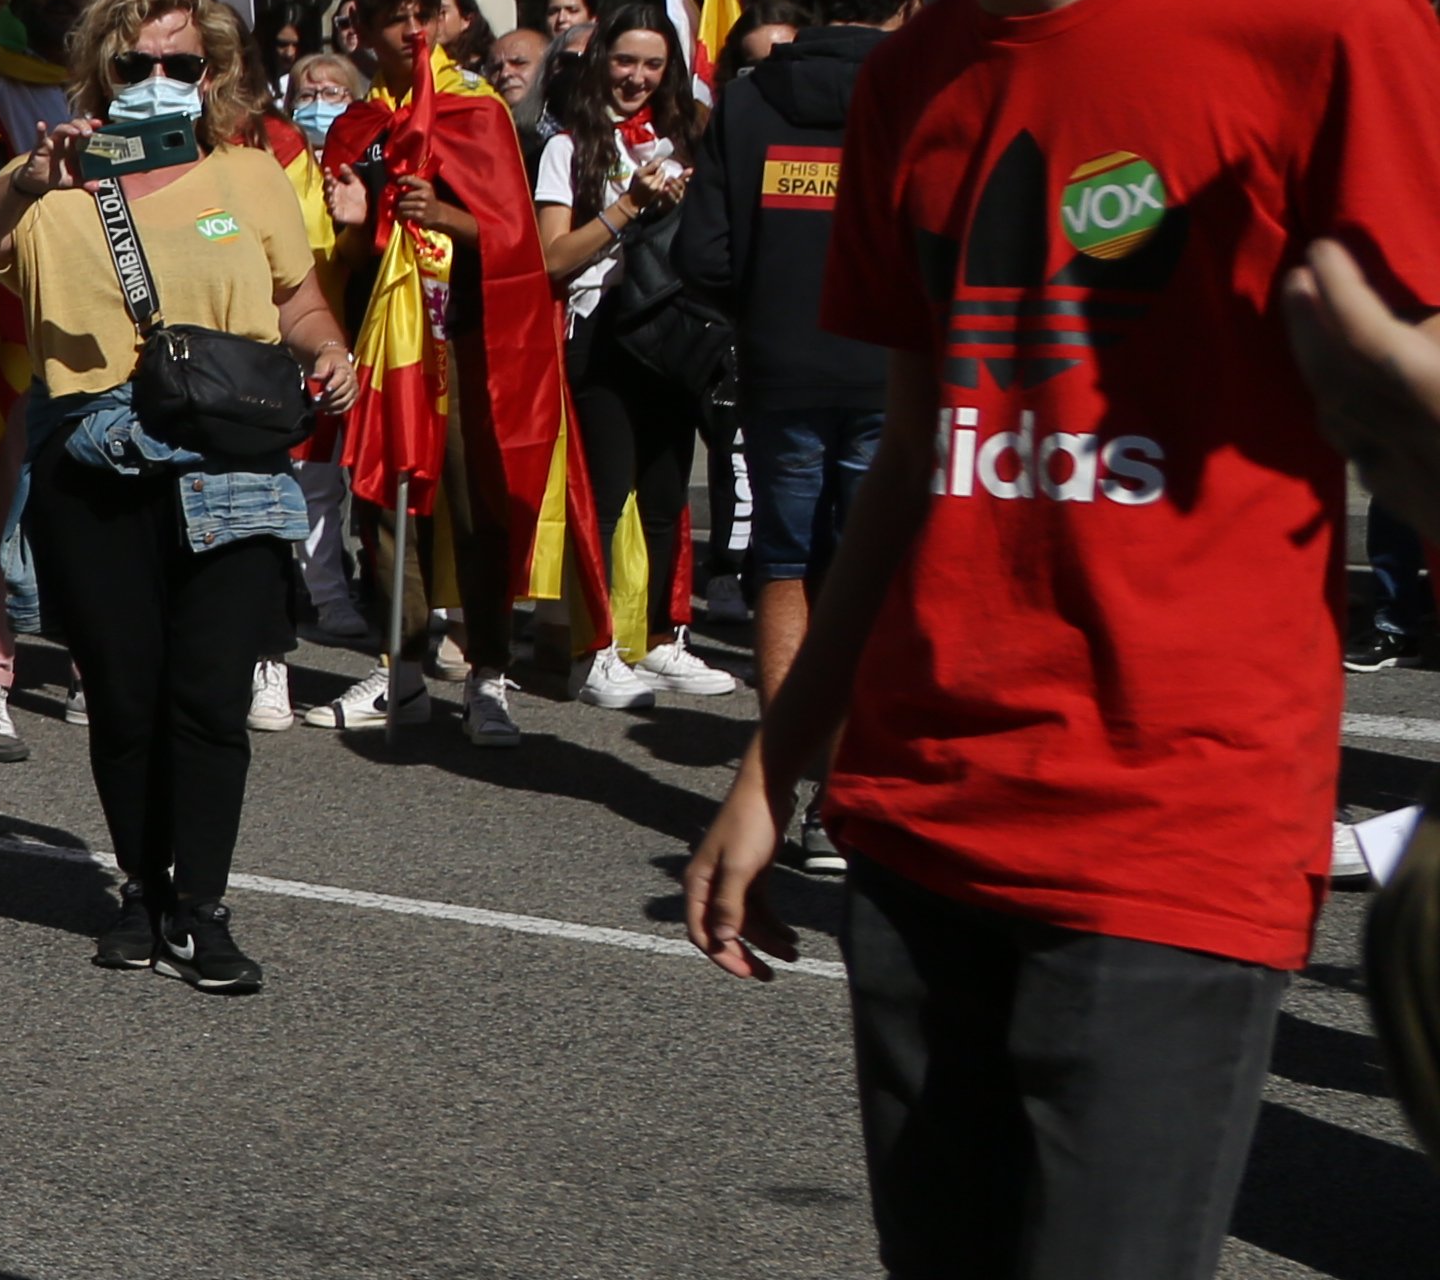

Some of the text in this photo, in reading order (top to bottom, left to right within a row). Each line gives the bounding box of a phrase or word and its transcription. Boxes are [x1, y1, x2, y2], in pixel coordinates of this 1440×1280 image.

[781, 162, 840, 178] THIS IS
[776, 178, 837, 195] SPAIN
[1061, 173, 1164, 233] VOX
[198, 217, 239, 237] VOX
